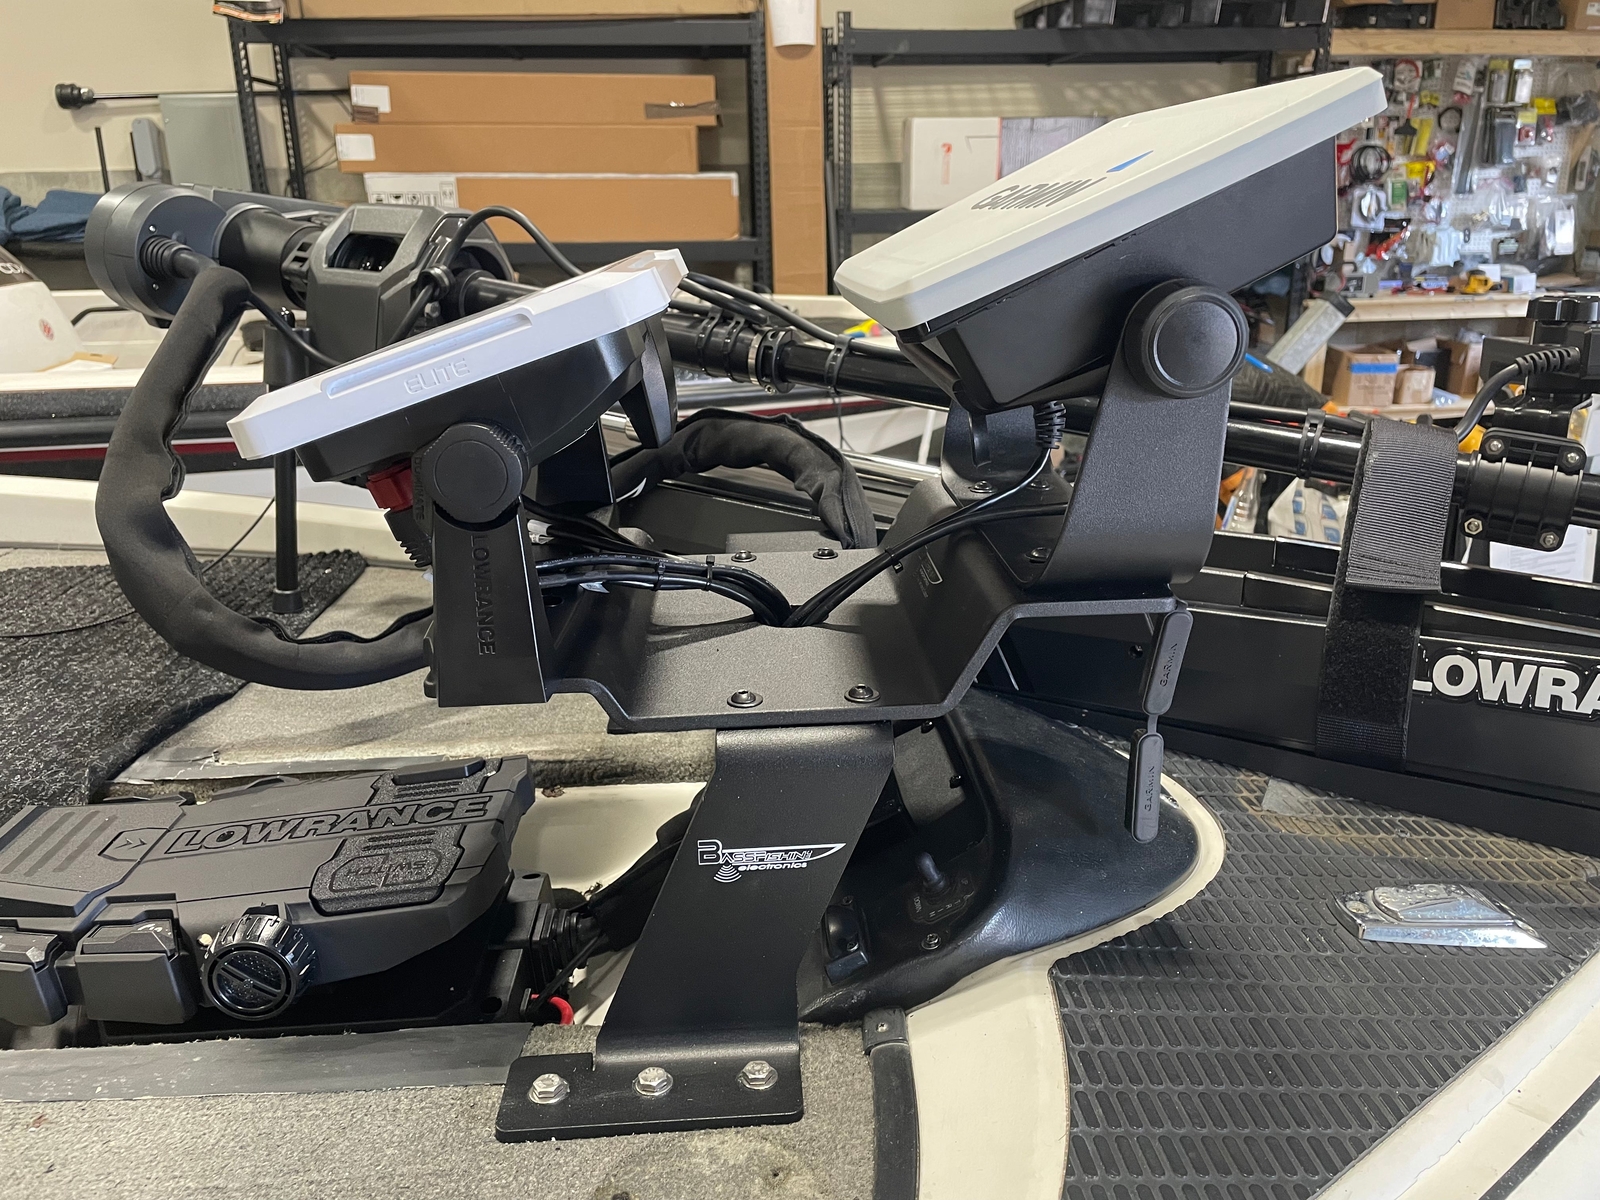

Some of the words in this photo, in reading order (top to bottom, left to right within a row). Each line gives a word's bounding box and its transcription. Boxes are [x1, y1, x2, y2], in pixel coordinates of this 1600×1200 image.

[971, 176, 1107, 210] GARMIN
[404, 358, 470, 394] ELITE
[470, 534, 496, 656] LOWRANCE
[1159, 642, 1178, 687] GARMIN
[1144, 765, 1155, 811] GARMIN
[164, 796, 493, 854] LOWRANCE
[738, 862, 808, 872] electronics
